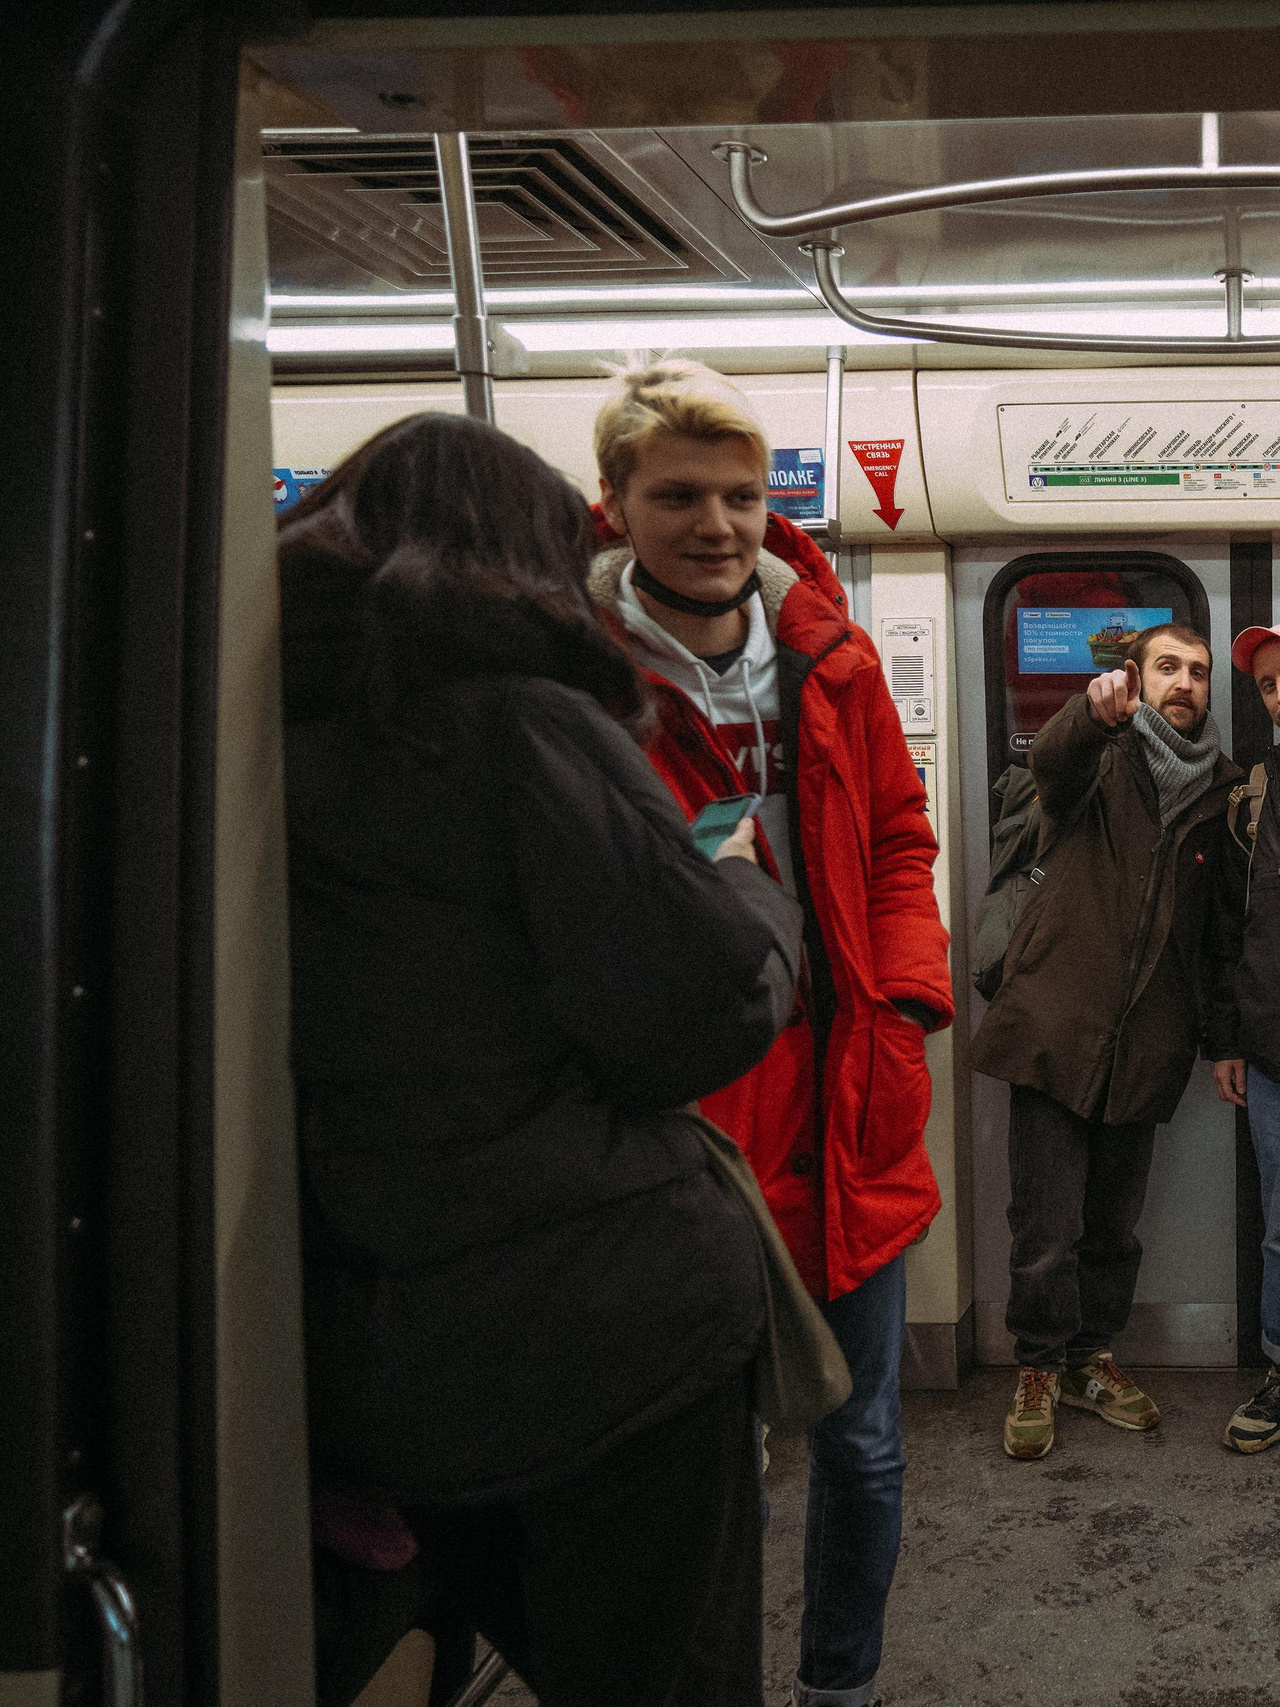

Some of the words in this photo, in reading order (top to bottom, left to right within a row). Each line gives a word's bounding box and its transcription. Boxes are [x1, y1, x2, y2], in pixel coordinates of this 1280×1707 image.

[1214, 415, 1233, 436] НЕВСКОГО
[1088, 430, 1116, 459] ПРОЛЕТАРСКАЯ
[1123, 426, 1154, 458] ЛОМОНОСОВСКАЯ
[1158, 429, 1186, 458] ЕЛИЗАРОВСКАЯ
[1228, 432, 1253, 458] МАЯКОВСКАЯ
[769, 470, 817, 486] ПОЛКЕ
[1123, 476, 1139, 484] (LINE
